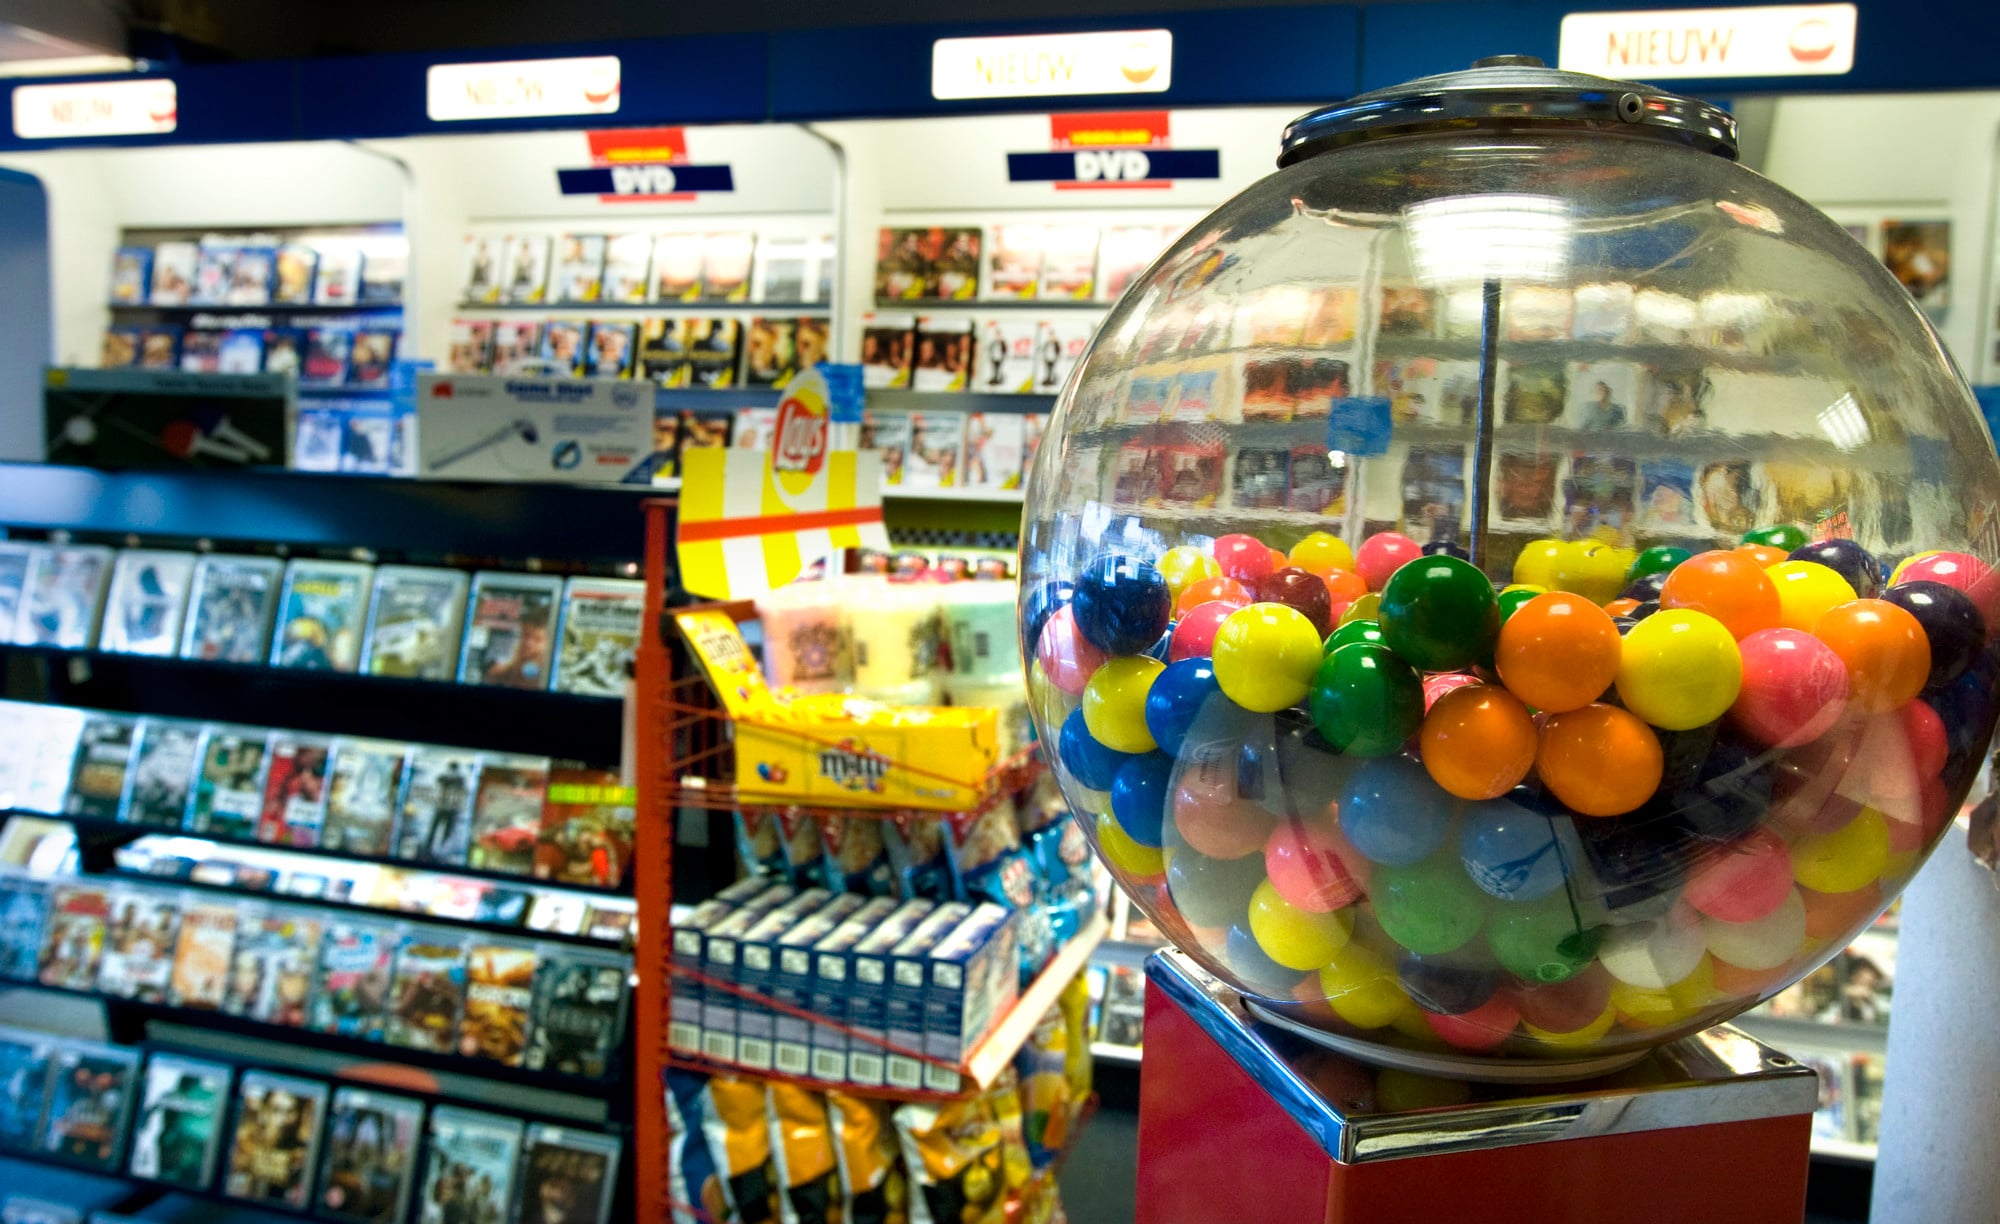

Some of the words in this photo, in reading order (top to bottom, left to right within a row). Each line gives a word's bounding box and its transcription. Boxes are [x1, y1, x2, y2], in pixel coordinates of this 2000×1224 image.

[1607, 27, 1733, 65] NIEUW
[975, 52, 1077, 85] NIEUW
[611, 165, 676, 195] DVD
[1074, 151, 1150, 181] DVD
